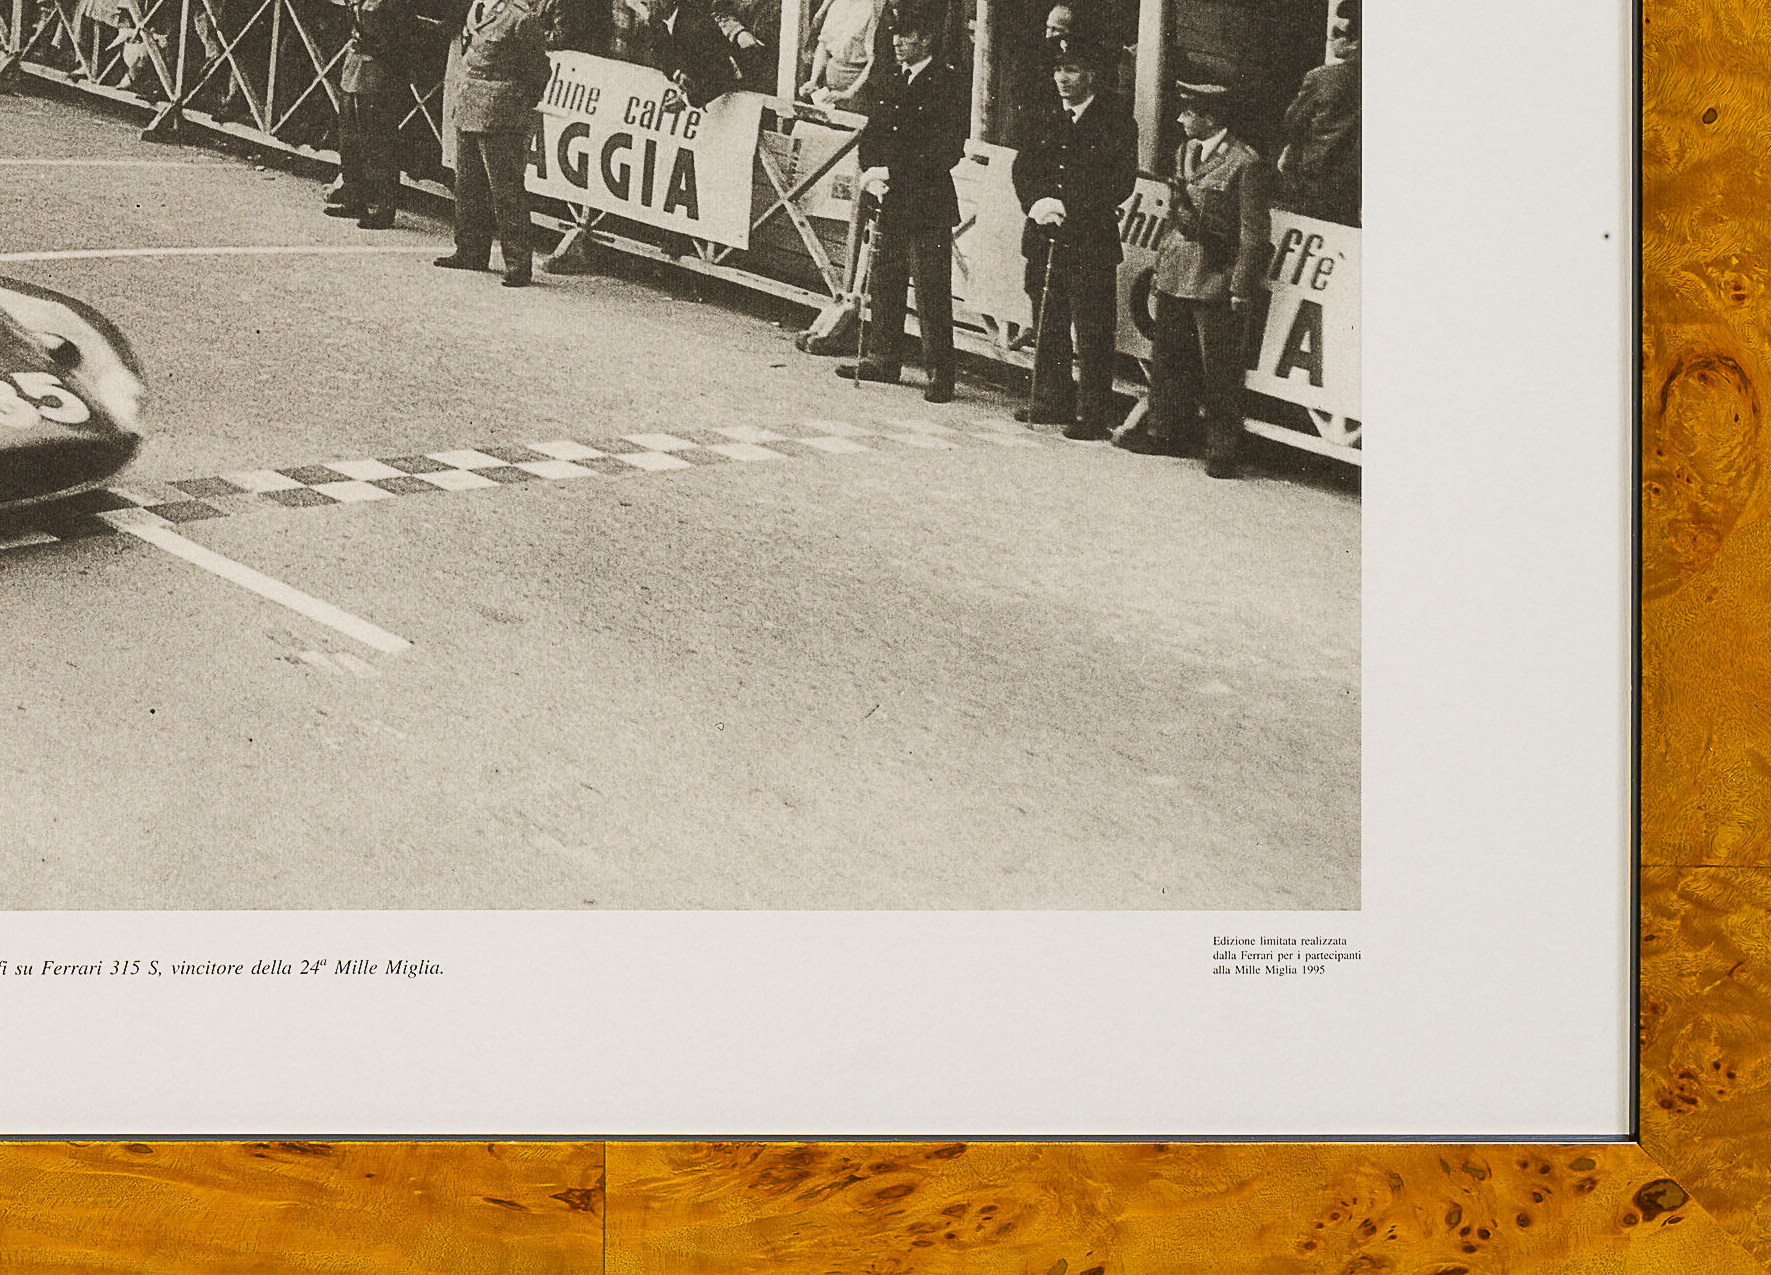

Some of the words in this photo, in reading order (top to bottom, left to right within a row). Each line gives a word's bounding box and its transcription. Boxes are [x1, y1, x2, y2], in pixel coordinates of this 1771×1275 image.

[1275, 298, 1325, 388] A
[1212, 935, 1256, 946] Edizione
[1259, 935, 1297, 946] limitata
[1300, 935, 1348, 946] realizzata
[1212, 950, 1237, 961] dalla
[1240, 950, 1274, 961] Ferrari
[1277, 952, 1294, 963] per
[1304, 950, 1362, 963] partecipanti
[14, 965, 33, 976] su
[41, 960, 103, 976] Ferrari
[109, 960, 141, 976] 315
[147, 960, 162, 977] S,
[171, 960, 244, 975] vincitore
[250, 959, 292, 975] della
[334, 959, 378, 975] Mille
[385, 959, 444, 979] Miglia.
[1212, 964, 1231, 975] alla
[1234, 964, 1262, 975] Mille
[1264, 964, 1298, 977] Miglia
[1302, 964, 1326, 975] 1995
